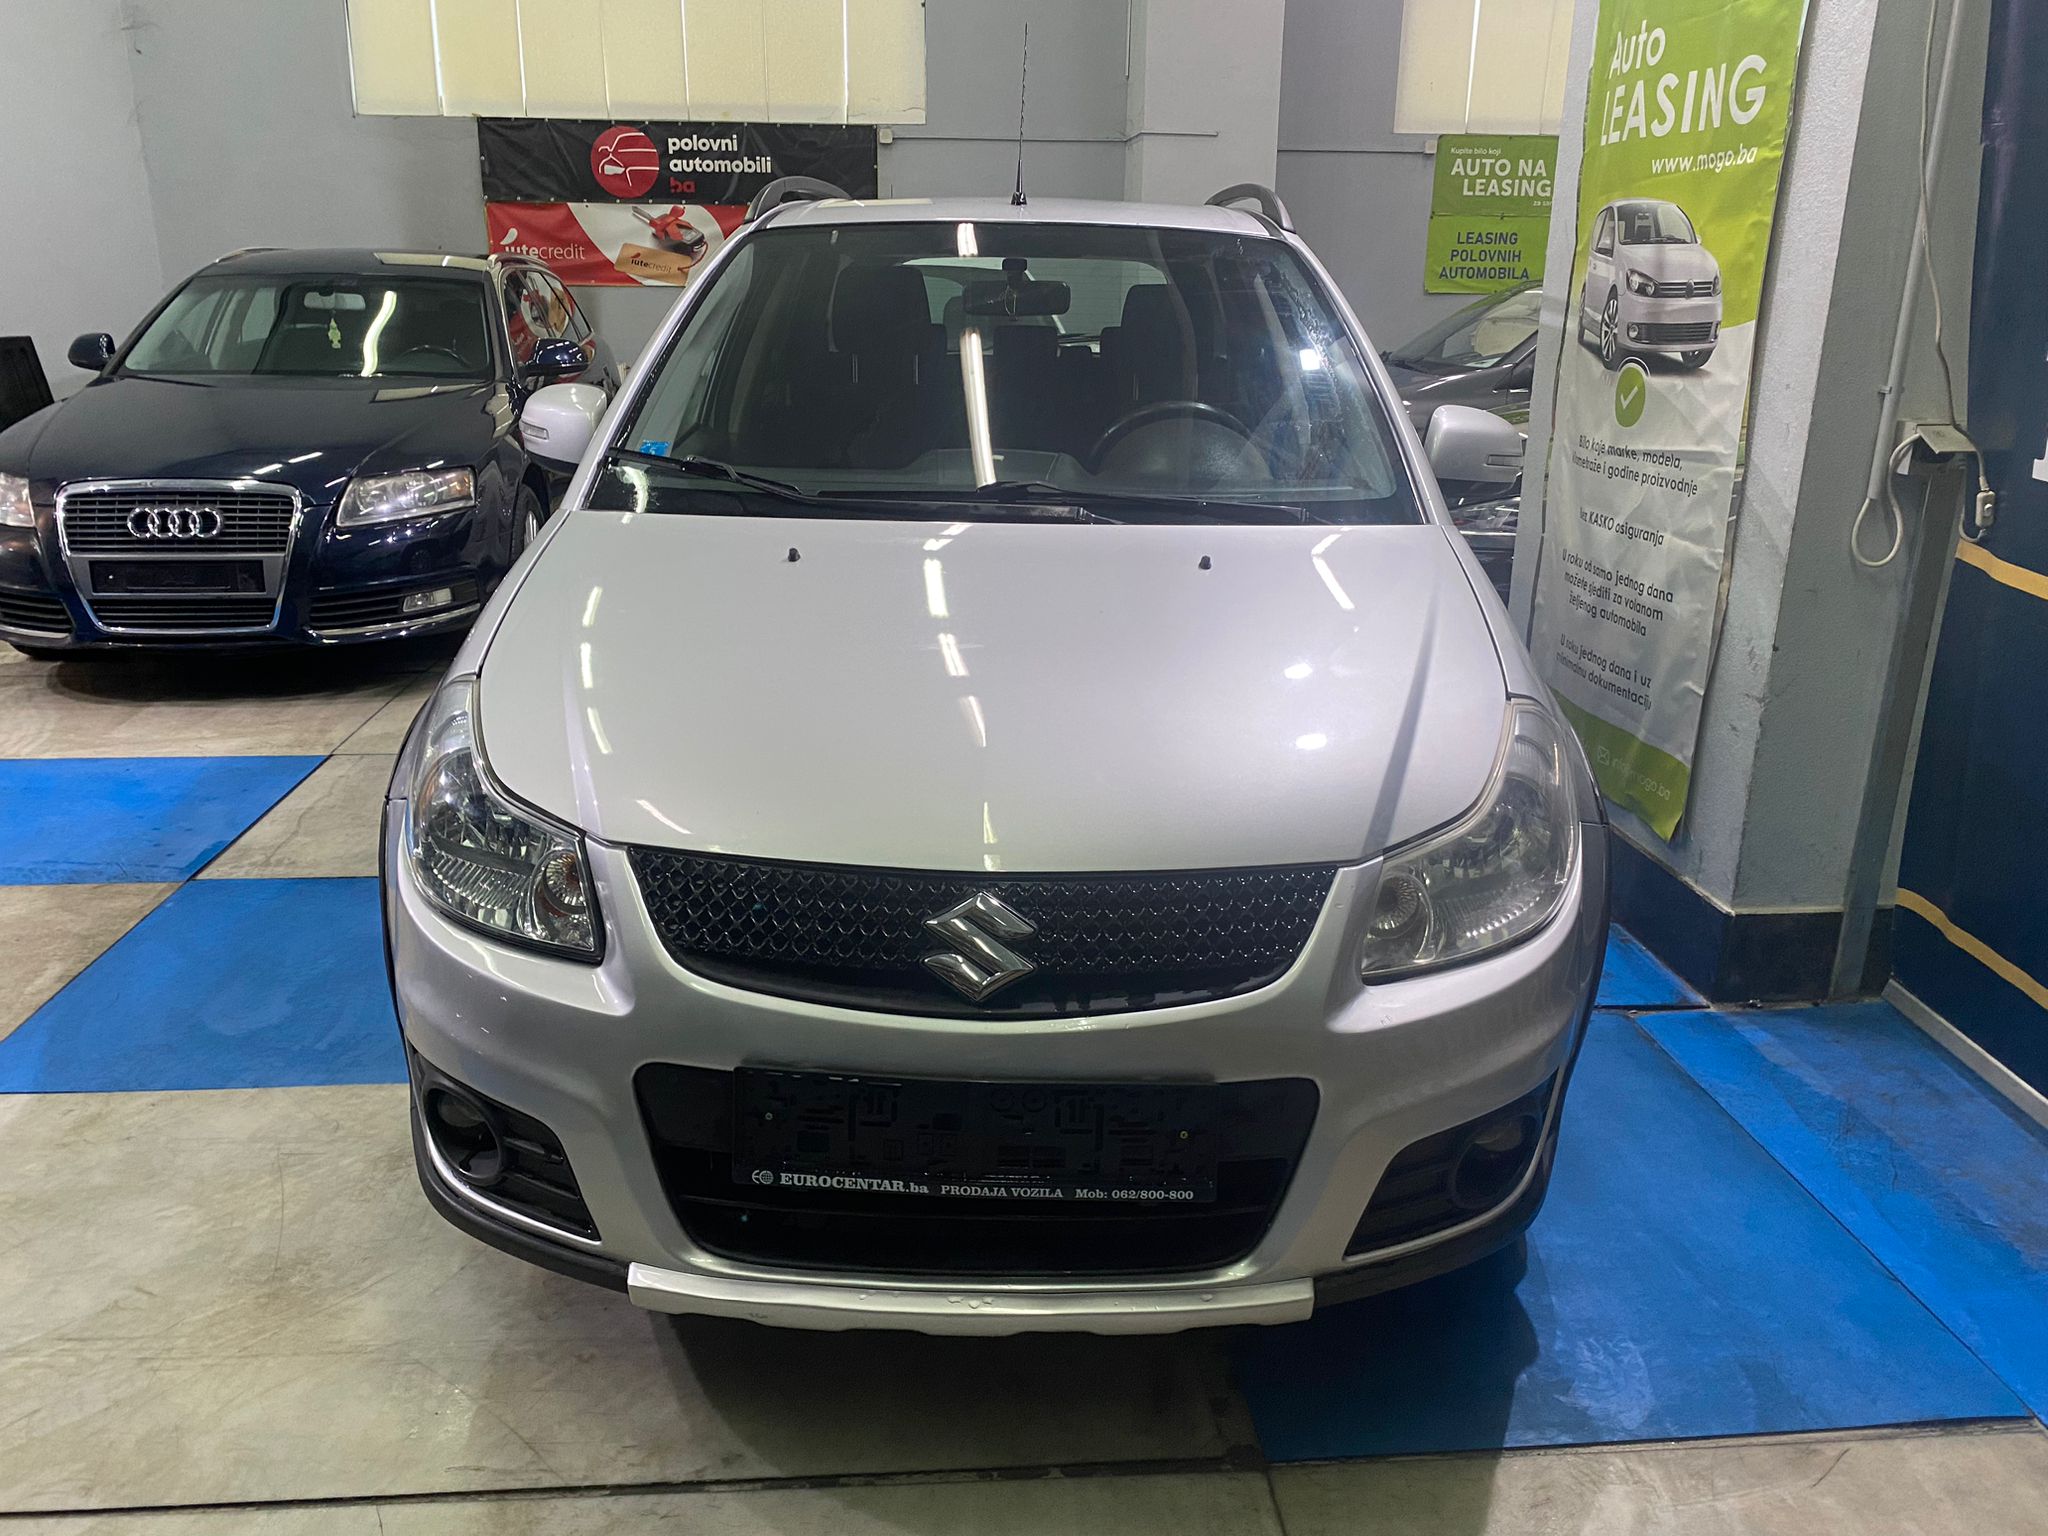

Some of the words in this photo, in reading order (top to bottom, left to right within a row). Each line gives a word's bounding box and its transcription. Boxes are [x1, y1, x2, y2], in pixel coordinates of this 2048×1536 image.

[1609, 19, 1666, 80] Auto
[1600, 54, 1767, 146] LEASING
[667, 134, 738, 155] polovni
[1651, 144, 1758, 174] www.mogo.ba
[669, 156, 772, 173] automobili
[1450, 158, 1511, 177] AUTO
[1517, 159, 1547, 177] NA
[1462, 178, 1552, 197] LEASING
[1456, 231, 1518, 245] LEASING
[1449, 249, 1522, 263] POLOVNIH
[1439, 266, 1529, 280] AUTOMOBILA
[1607, 444, 1640, 462] marke,
[1642, 451, 1683, 471] modela,
[1603, 460, 1607, 475] i
[1607, 464, 1640, 482] godine
[1640, 472, 1698, 498] proizvodnje
[1588, 511, 1615, 531] KASKO
[1615, 521, 1665, 547] osiguranja
[1567, 552, 1584, 568] roku
[1614, 569, 1646, 597] jednog
[1646, 582, 1674, 603] dana
[1612, 592, 1623, 605] za
[1624, 597, 1663, 621] volanom
[1600, 608, 1647, 637] automobila
[1578, 644, 1608, 672] jednog
[1608, 660, 1632, 681] dana
[1632, 669, 1638, 683] i
[1640, 675, 1652, 689] uz
[779, 1172, 929, 1194] EUROCENTAR.ba
[940, 1185, 1007, 1198] PRODAJA
[1010, 1187, 1064, 1199] VOZILA
[1074, 1188, 1108, 1200] Mob:
[1111, 1189, 1195, 1201] 062/800-800
